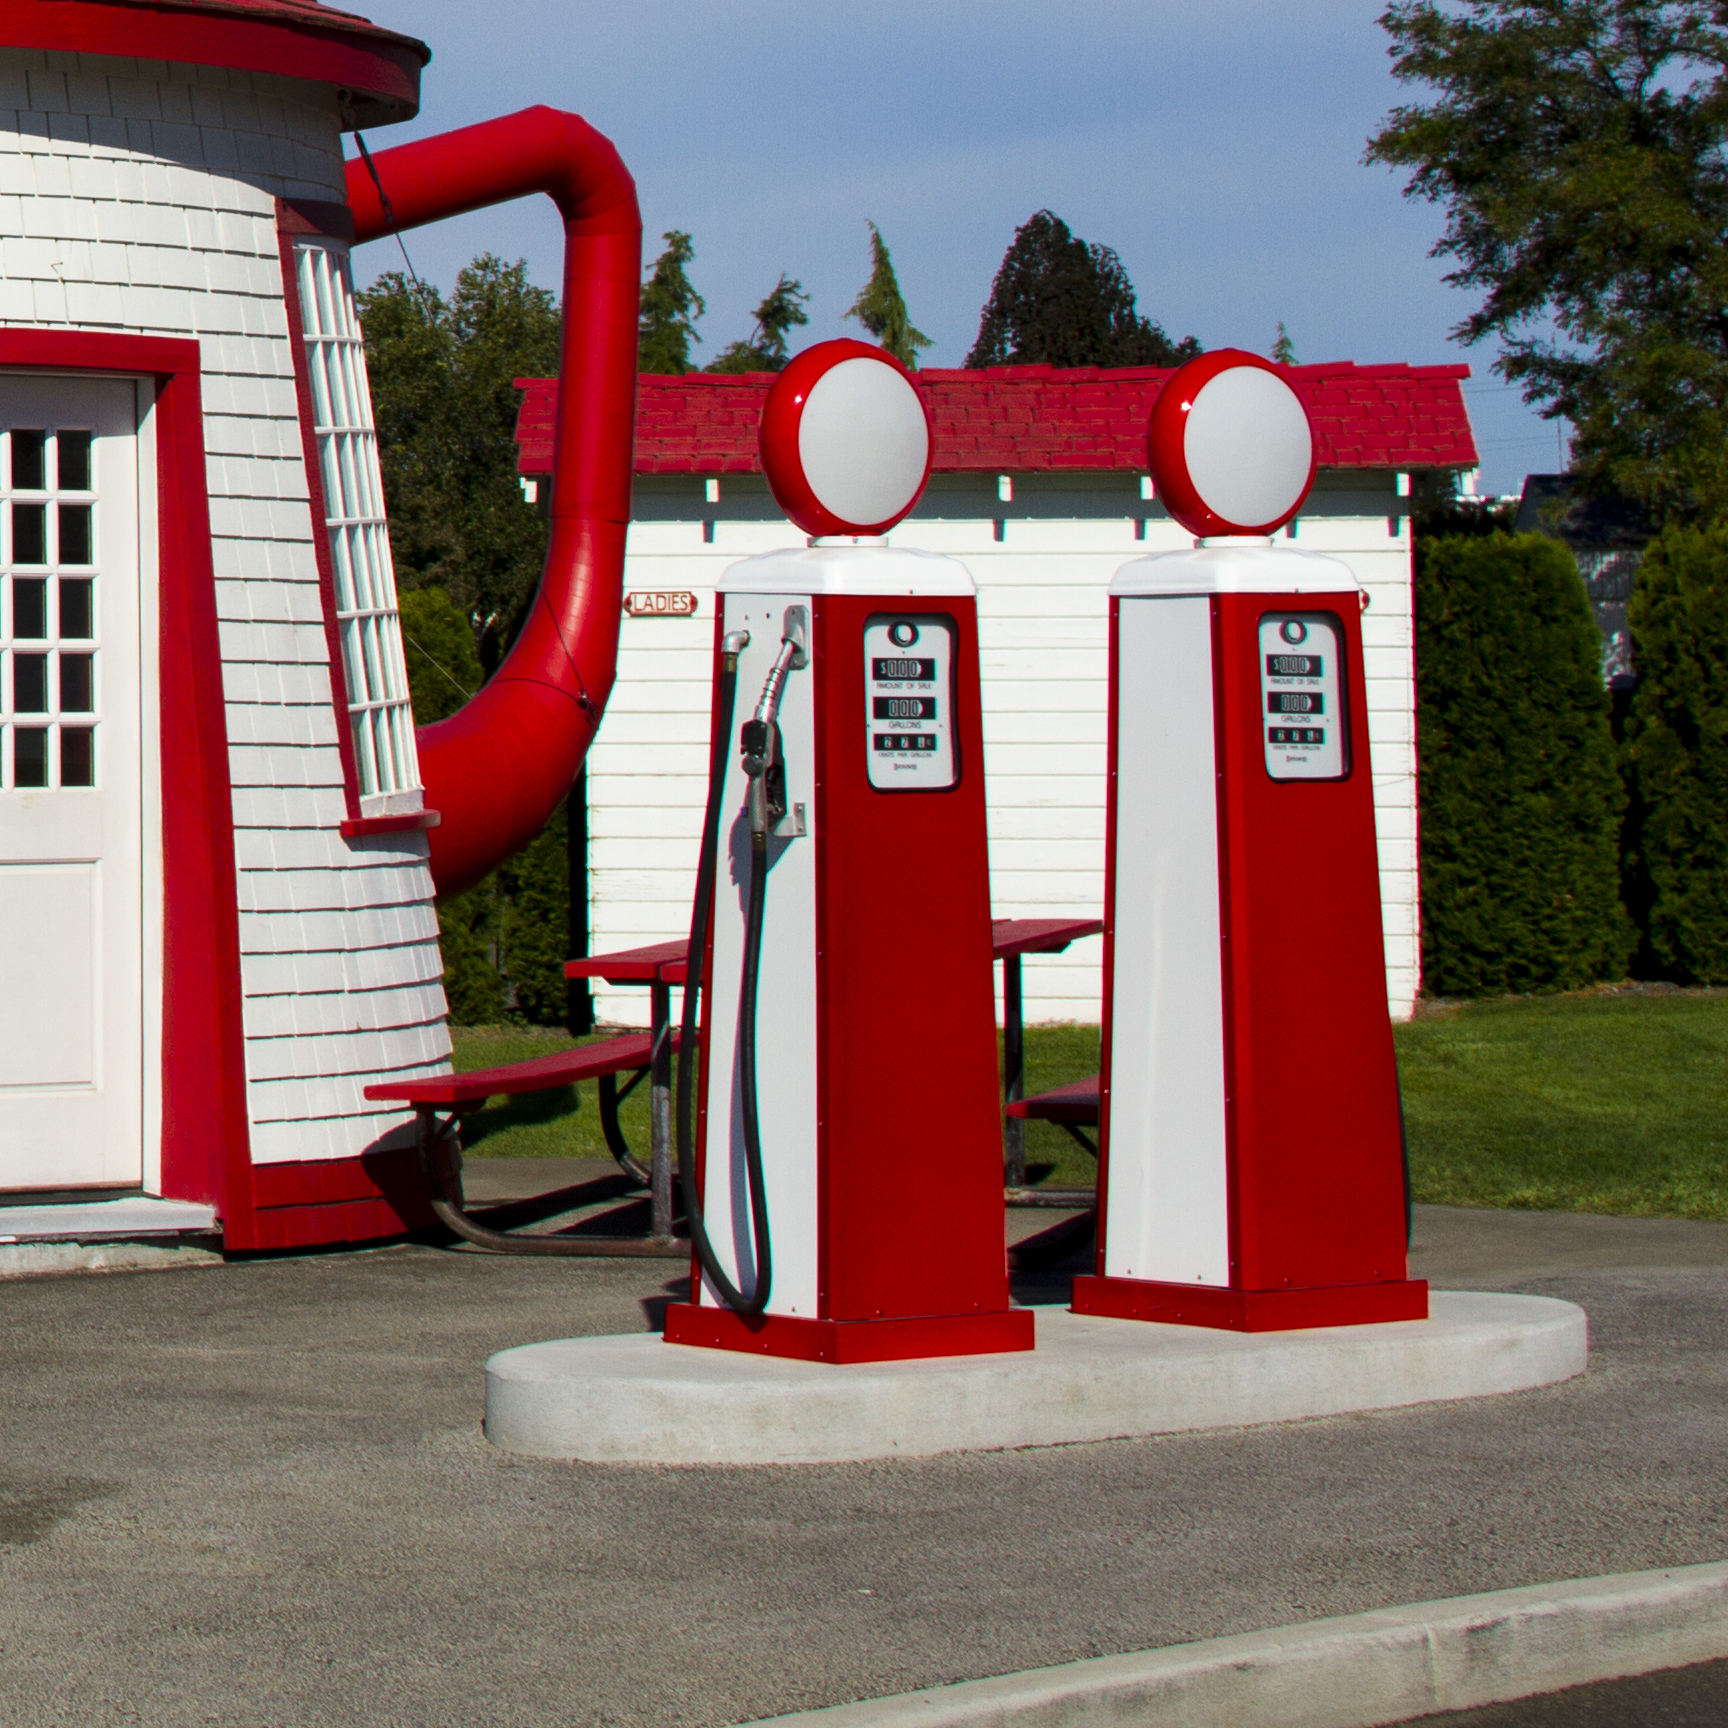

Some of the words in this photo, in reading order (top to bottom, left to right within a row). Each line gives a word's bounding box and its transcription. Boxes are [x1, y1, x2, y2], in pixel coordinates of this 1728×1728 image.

[633, 594, 689, 612] LADIES
[1281, 715, 1311, 723] GALLONS
[888, 720, 922, 729] GALLONS
